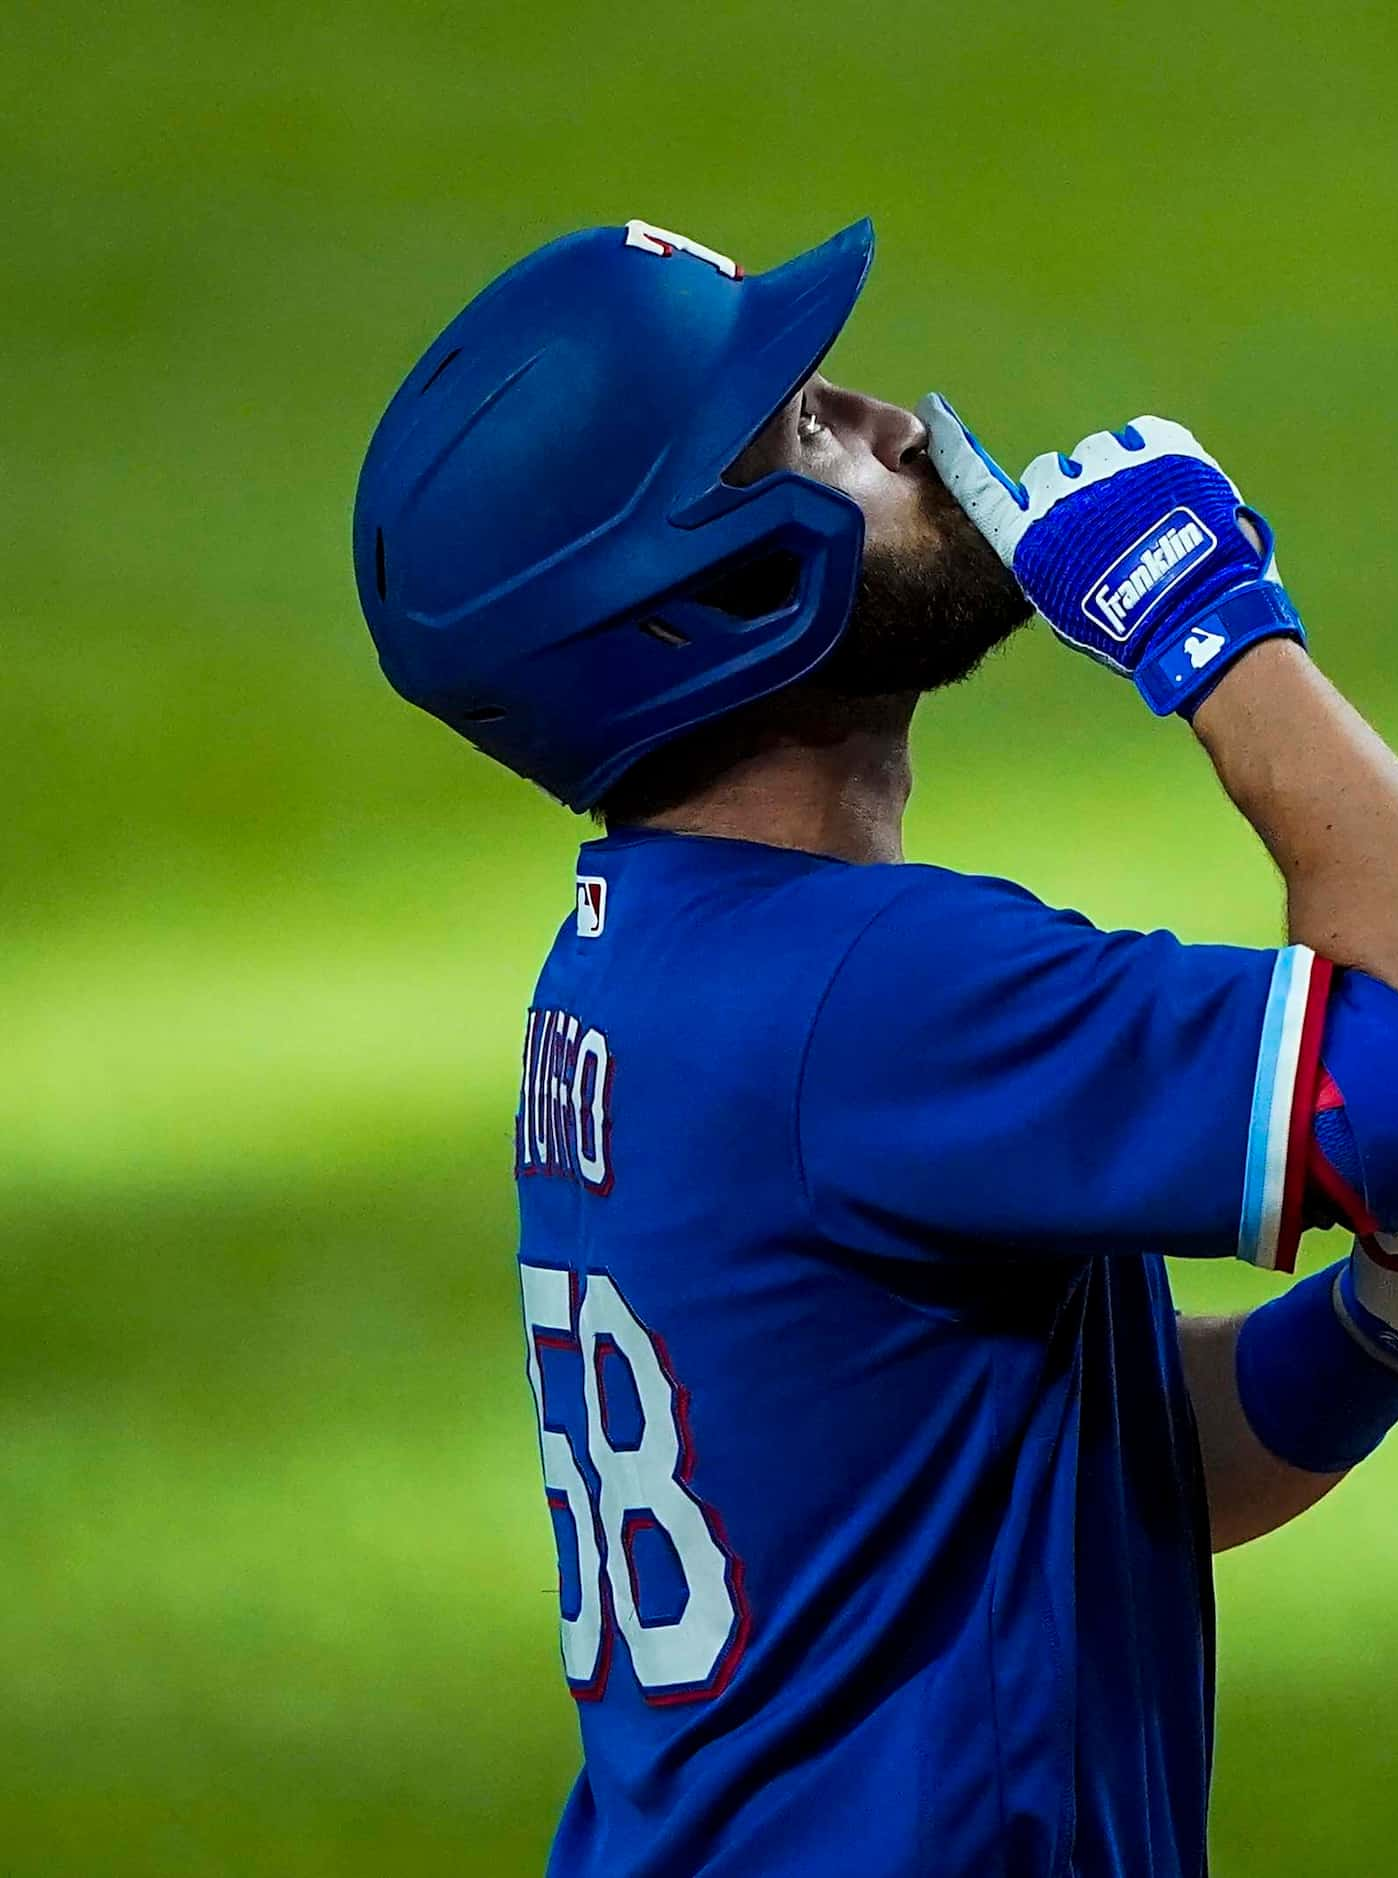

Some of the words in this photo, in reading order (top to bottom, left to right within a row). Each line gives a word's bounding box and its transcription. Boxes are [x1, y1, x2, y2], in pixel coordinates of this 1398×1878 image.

[1095, 521, 1204, 634] Franklin
[519, 1008, 614, 1194] IUFFO
[519, 1258, 747, 1704] 58
